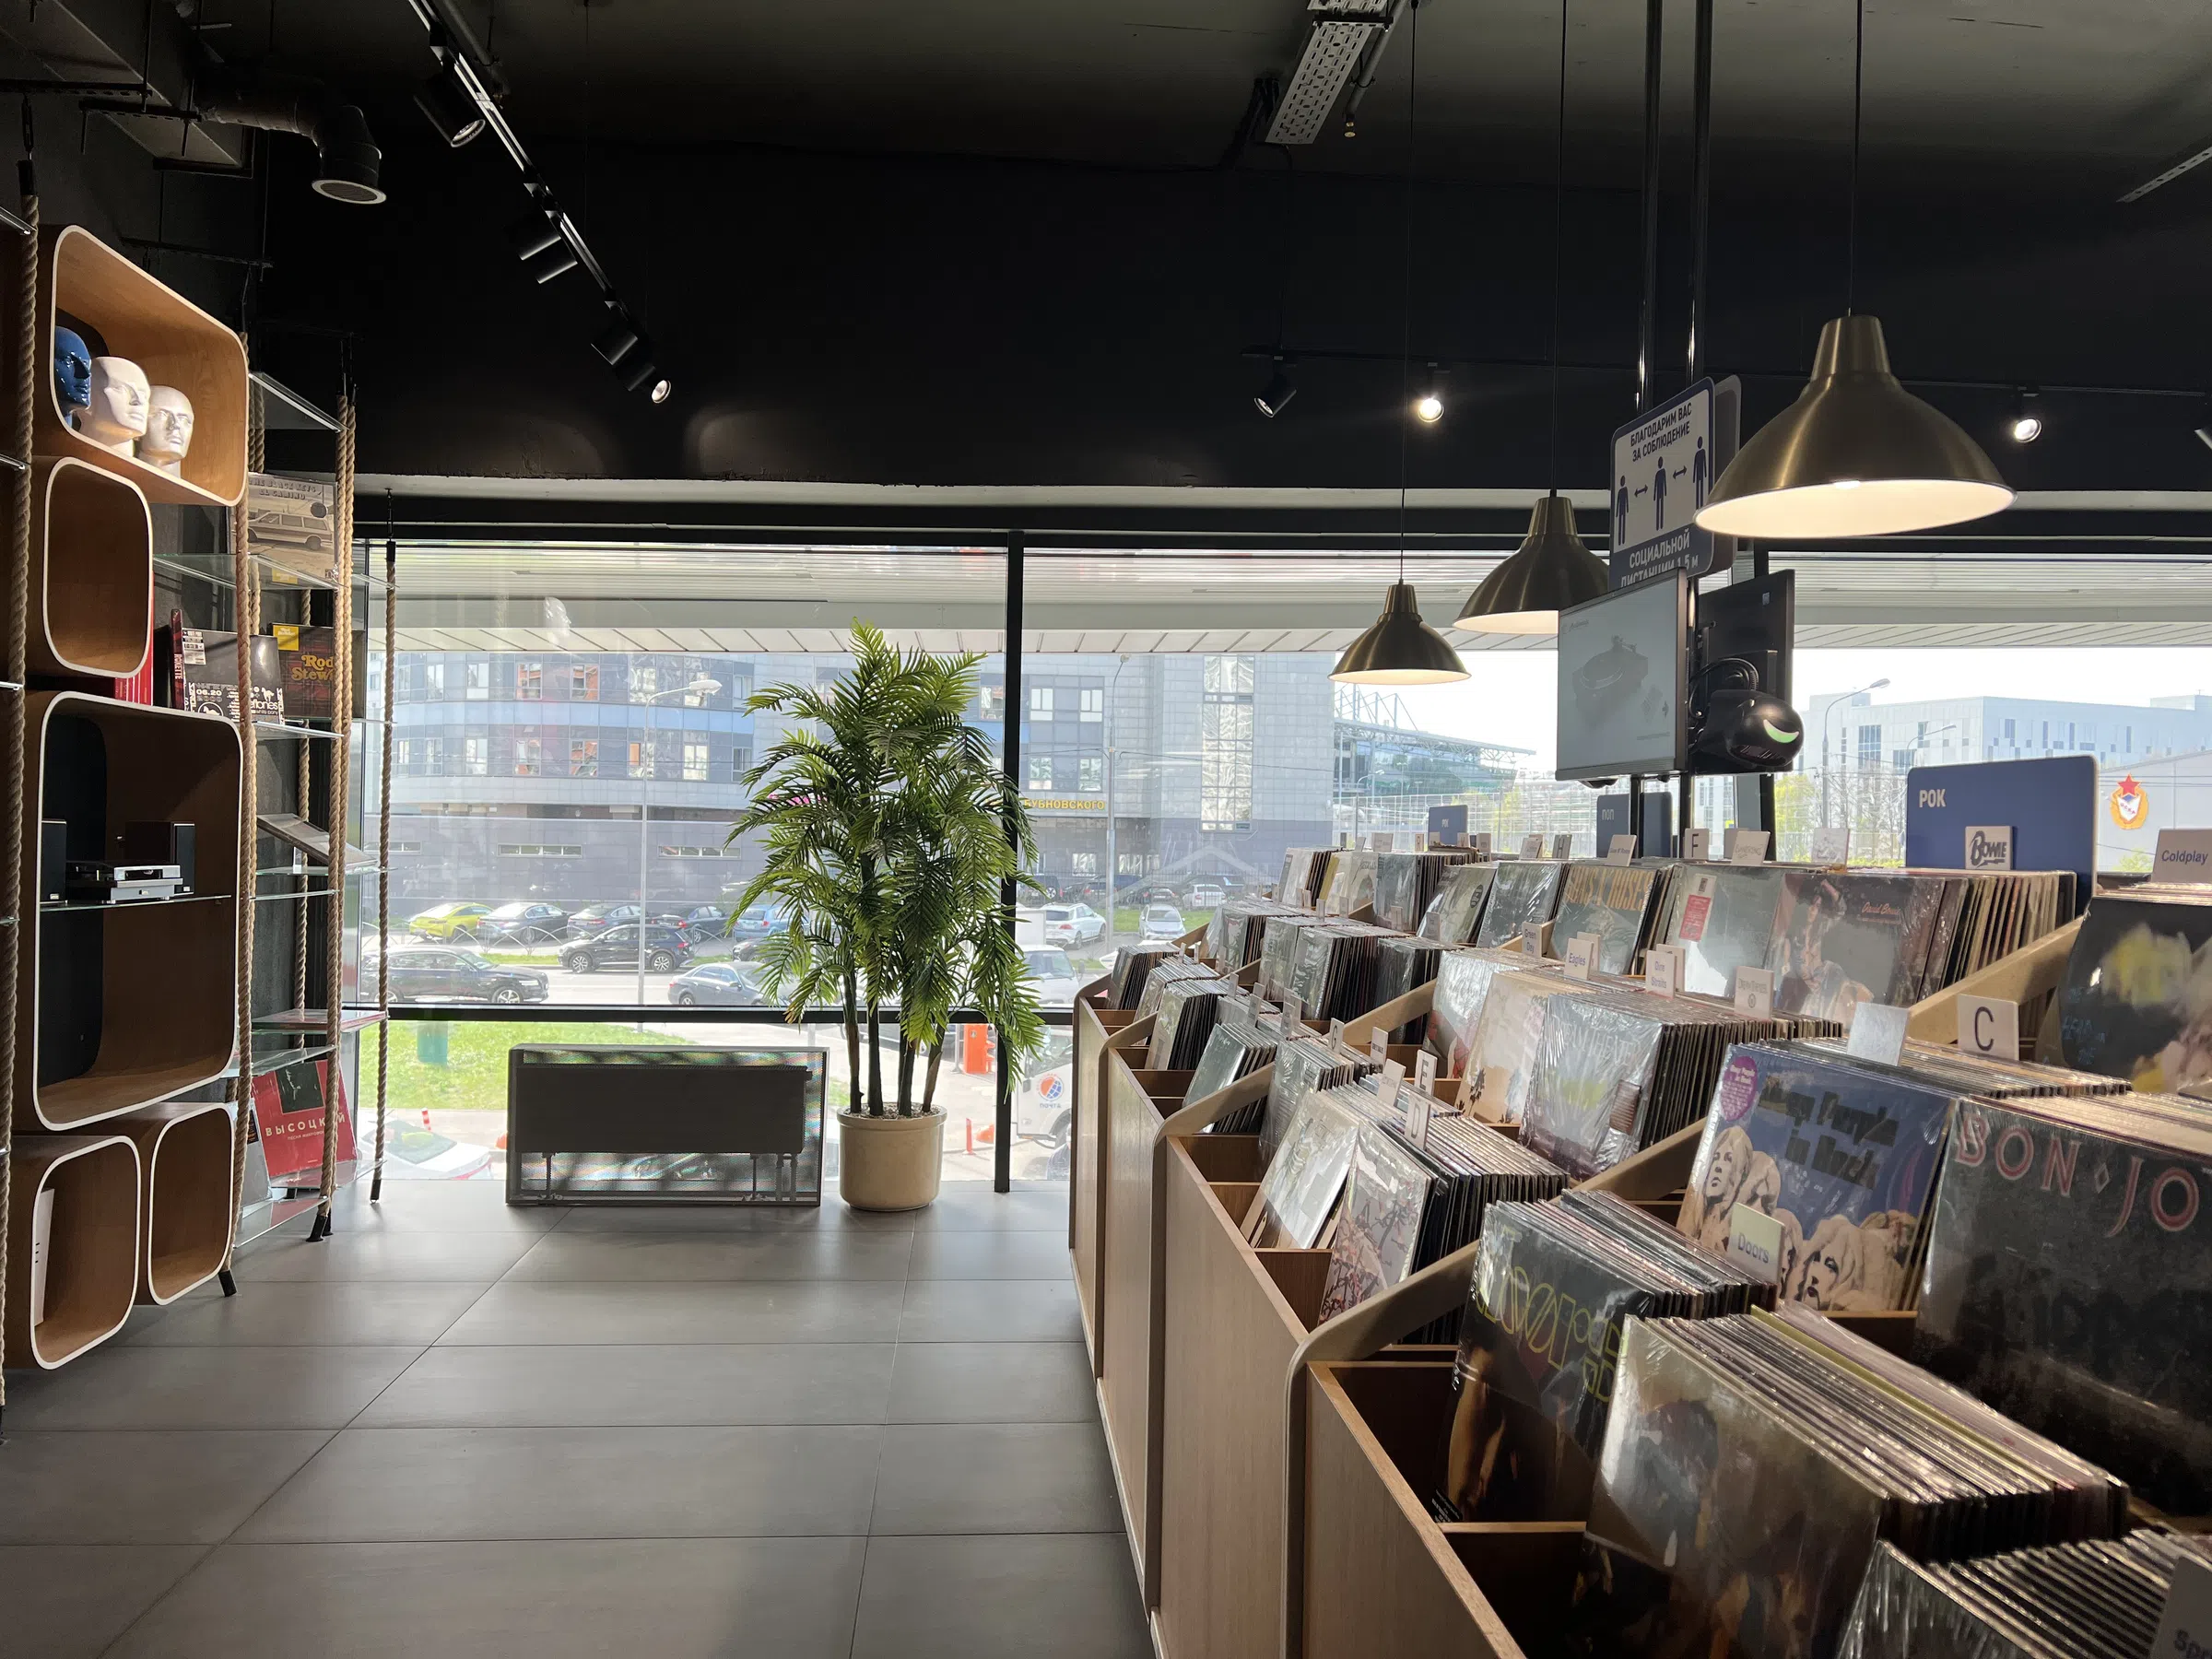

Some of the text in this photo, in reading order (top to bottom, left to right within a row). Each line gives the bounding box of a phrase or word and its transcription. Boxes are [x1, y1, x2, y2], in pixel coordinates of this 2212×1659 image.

[1630, 403, 1692, 447] БЛАГОДАРИМ ВАС
[1632, 421, 1690, 462] ЗА СОБЛЮДЕНИЕ
[1630, 528, 1690, 569] СОЦИАЛЬНОЙ
[301, 655, 334, 671] Rod
[251, 699, 278, 711] eftones
[1024, 799, 1105, 810] БУБНОВСКОГО
[1919, 789, 1946, 807] РОК
[1692, 833, 1700, 858] F
[2161, 849, 2208, 865] Coldplay
[1569, 952, 1586, 968] Eagles
[1974, 1006, 1994, 1052] C
[265, 1112, 345, 1136] ВЫСОЦКЙ
[1410, 1103, 1420, 1139] D
[1955, 1113, 2212, 1238] BON JO
[1737, 1228, 1770, 1265] Doors
